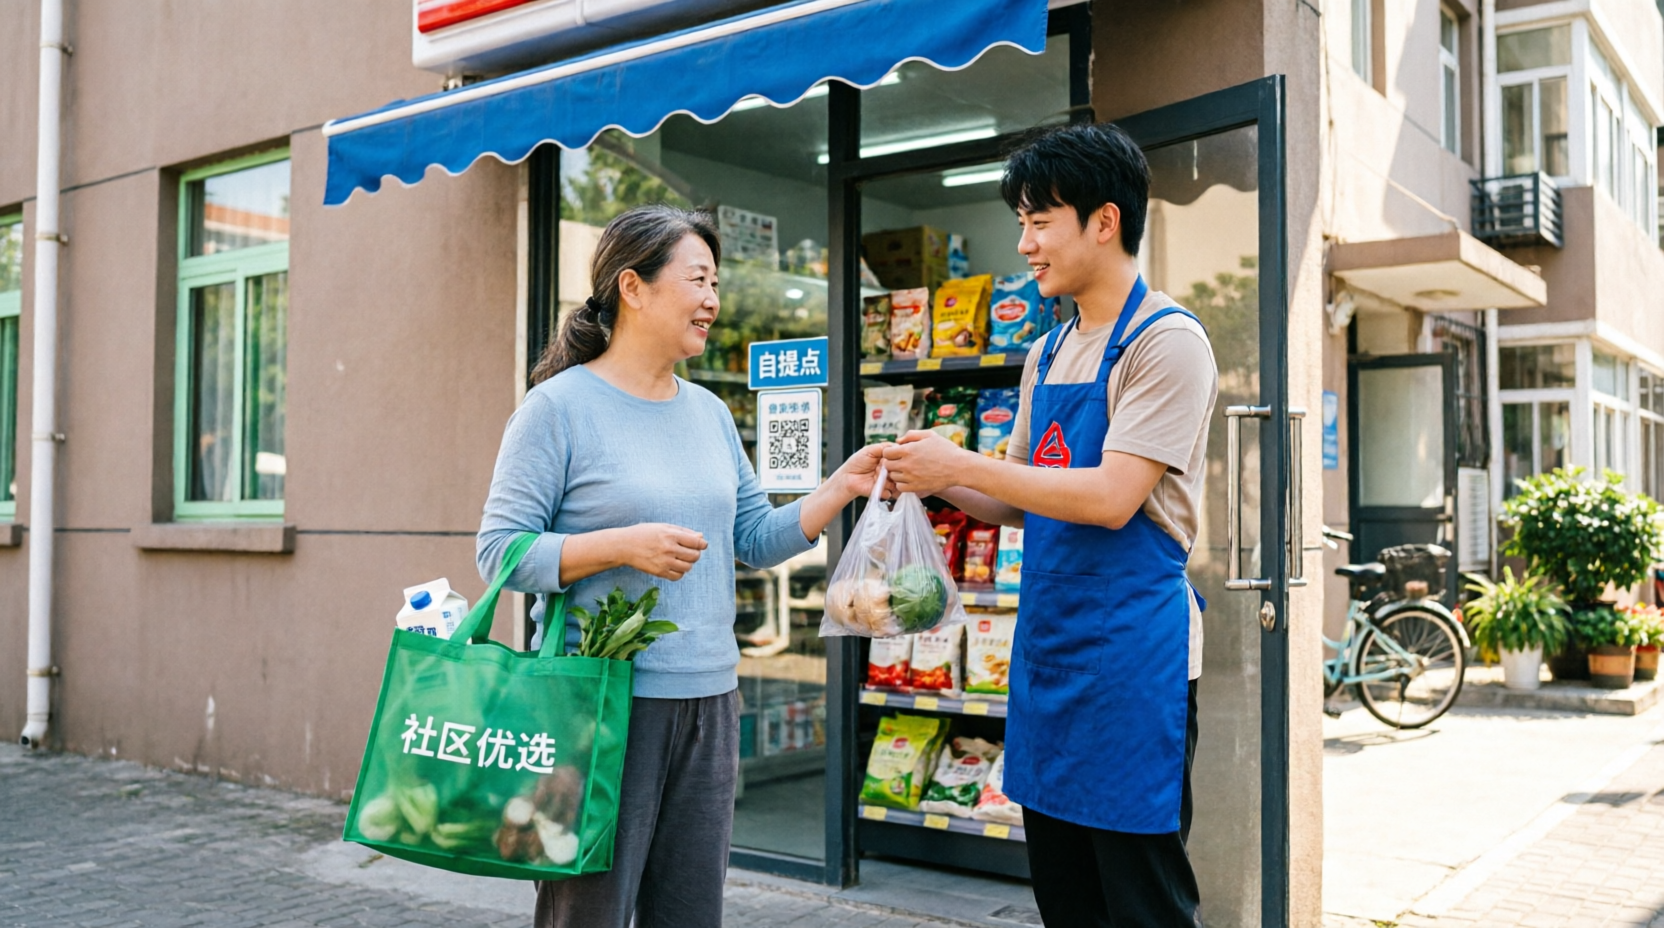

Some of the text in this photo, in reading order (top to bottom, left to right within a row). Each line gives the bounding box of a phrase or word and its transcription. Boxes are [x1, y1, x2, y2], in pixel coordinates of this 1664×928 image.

[759, 348, 821, 379] 自提点
[401, 713, 556, 774] 社区优选
